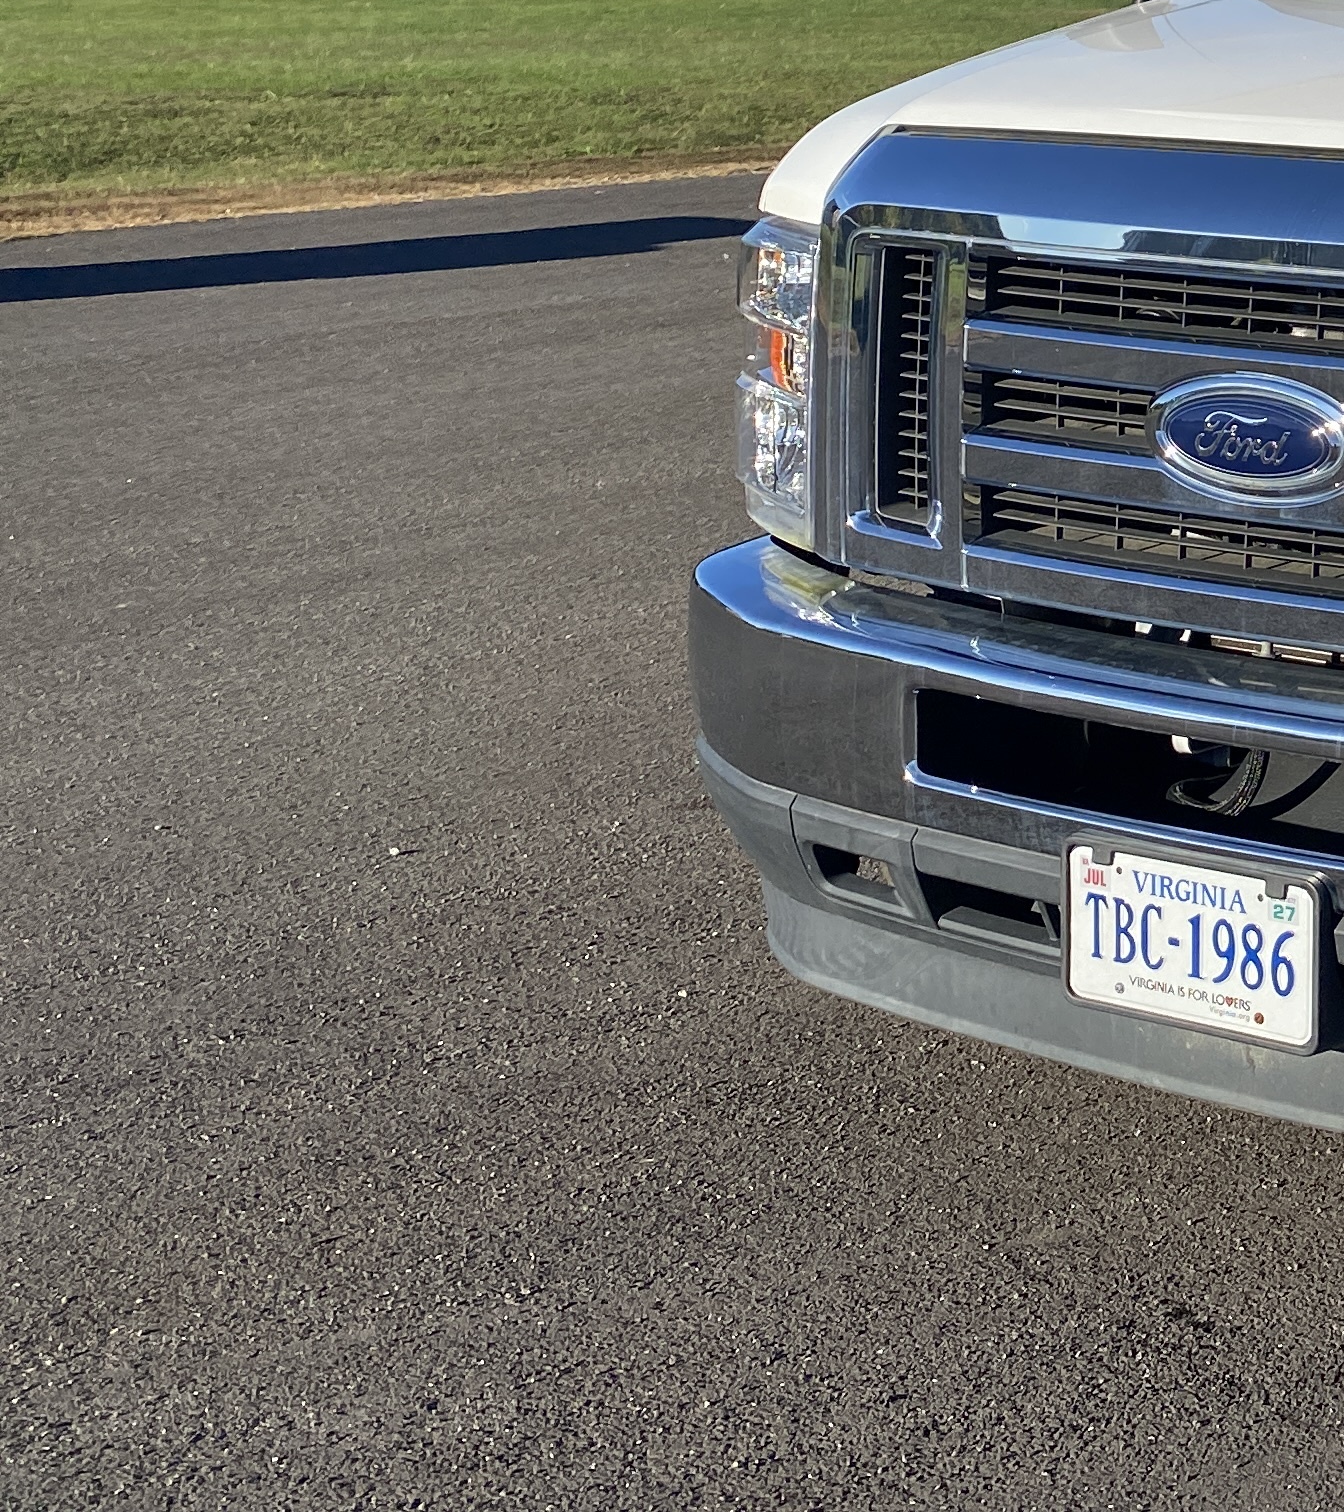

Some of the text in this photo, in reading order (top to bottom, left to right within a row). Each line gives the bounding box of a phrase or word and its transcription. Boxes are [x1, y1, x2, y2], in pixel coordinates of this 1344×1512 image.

[1195, 410, 1292, 466] Ford
[1084, 868, 1107, 887] JUL
[1132, 870, 1247, 914] VIRGINIA
[1273, 903, 1296, 922] 27
[1085, 891, 1295, 997] TBC-1986
[1129, 975, 1175, 996] VIRGINIA
[1177, 985, 1186, 997] IS
[1188, 988, 1210, 1004] FOR
